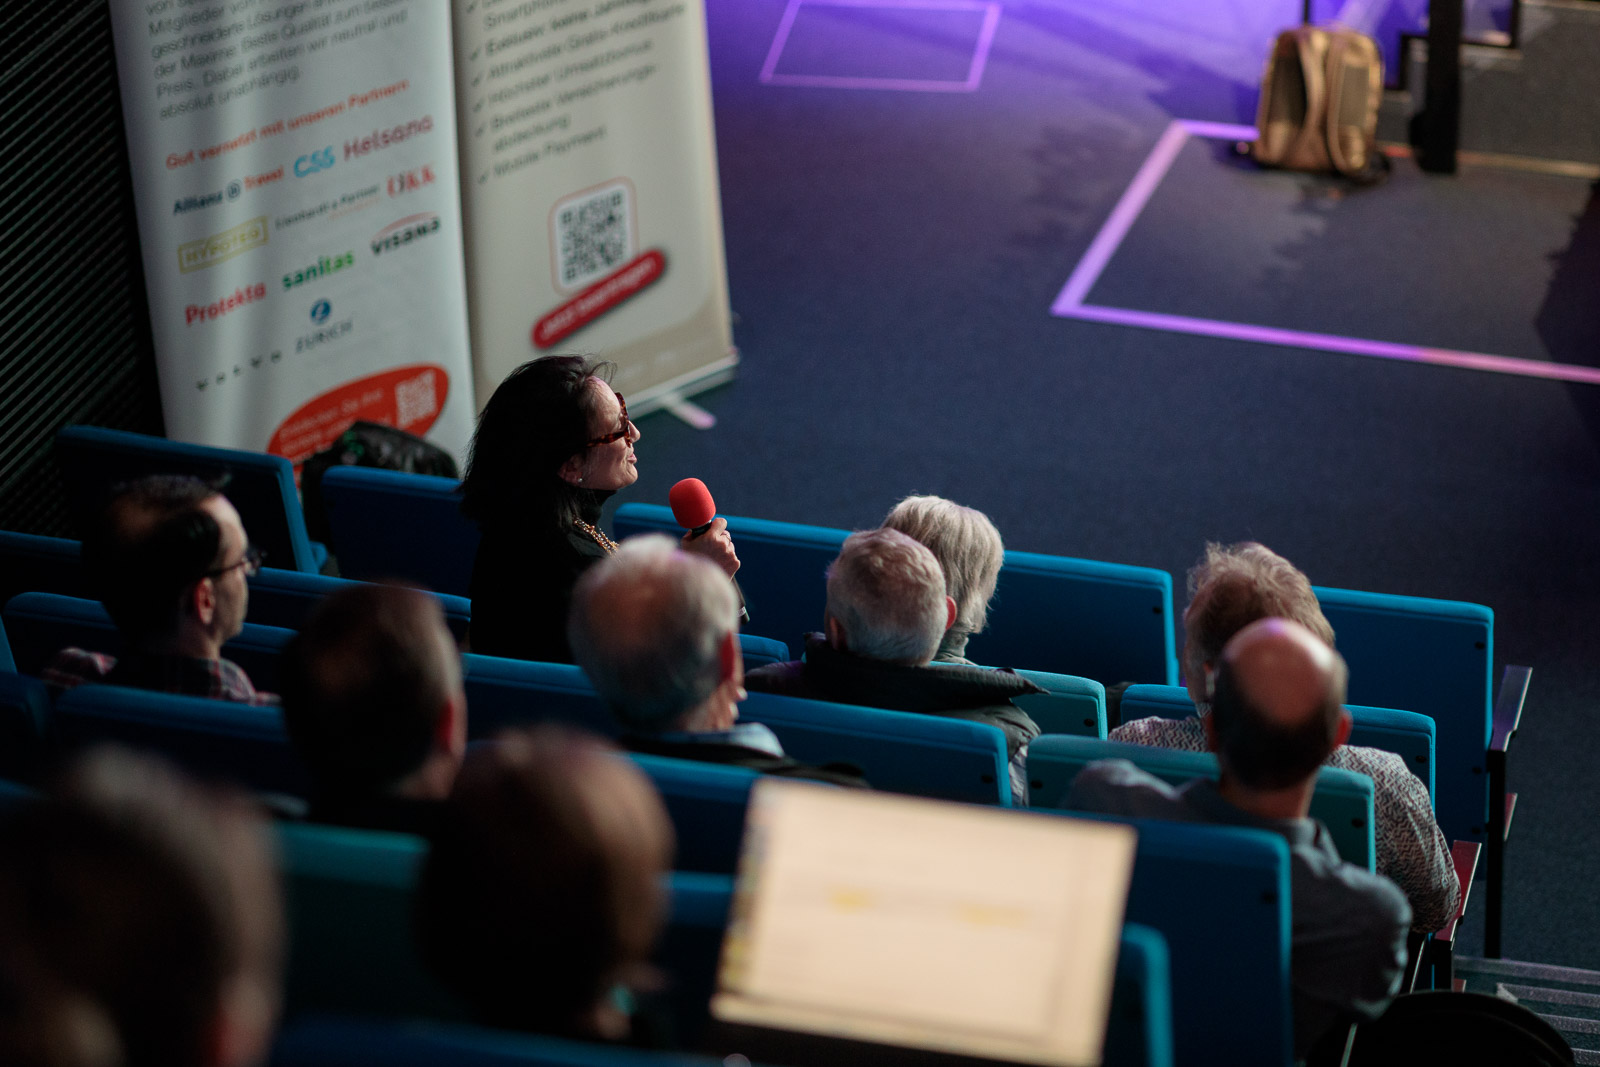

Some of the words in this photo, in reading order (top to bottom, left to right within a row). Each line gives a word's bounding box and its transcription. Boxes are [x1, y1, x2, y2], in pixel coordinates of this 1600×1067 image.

[165, 151, 196, 171] Gut
[260, 120, 285, 141] mit
[342, 114, 434, 162] Helsana
[293, 145, 336, 179] CSS
[172, 192, 224, 217] Allianz
[371, 216, 441, 256] visana
[282, 250, 356, 291] sanitas
[185, 282, 267, 327] Protekta
